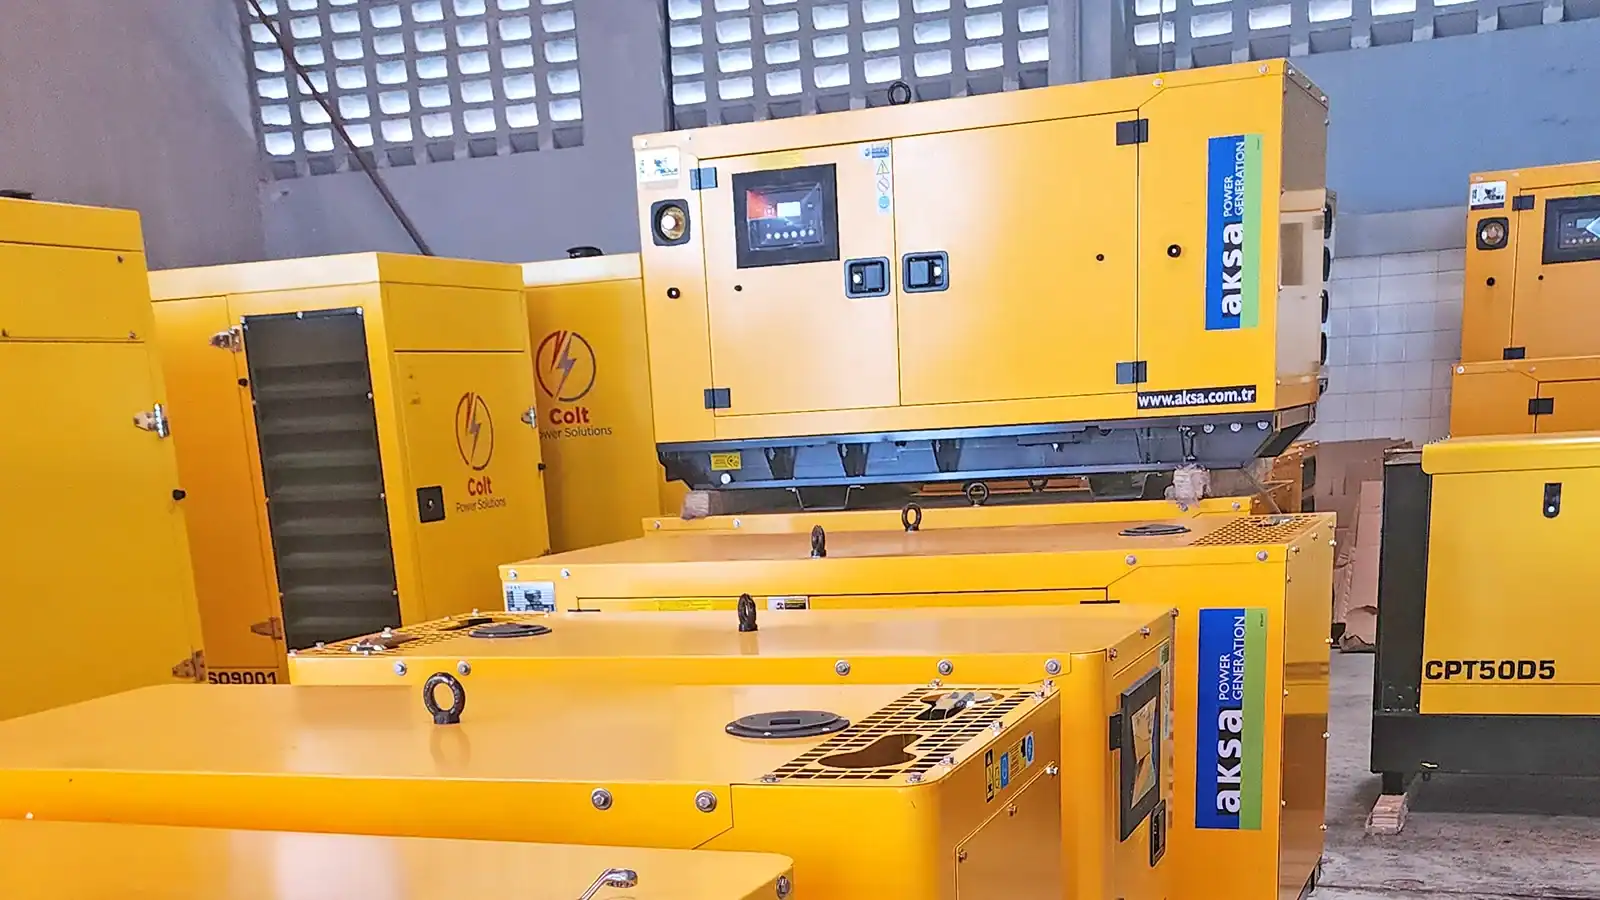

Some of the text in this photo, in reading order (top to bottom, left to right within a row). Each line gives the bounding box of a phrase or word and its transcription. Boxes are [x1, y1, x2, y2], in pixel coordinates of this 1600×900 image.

[1234, 141, 1245, 216] GENERATION
[1223, 175, 1233, 217] POWER
[1221, 222, 1244, 316] aksa
[1138, 387, 1255, 407] www.aksa.com.tr
[549, 406, 589, 425] Colt
[539, 426, 613, 440] ower Solutions
[467, 475, 492, 497] Colt
[456, 496, 506, 513] Power Solutions
[1232, 615, 1246, 701] GENERATION
[207, 671, 277, 685] SO9001
[1218, 653, 1230, 701] POWER
[1425, 659, 1556, 680] CPT50D5
[1216, 707, 1243, 814] aksa
